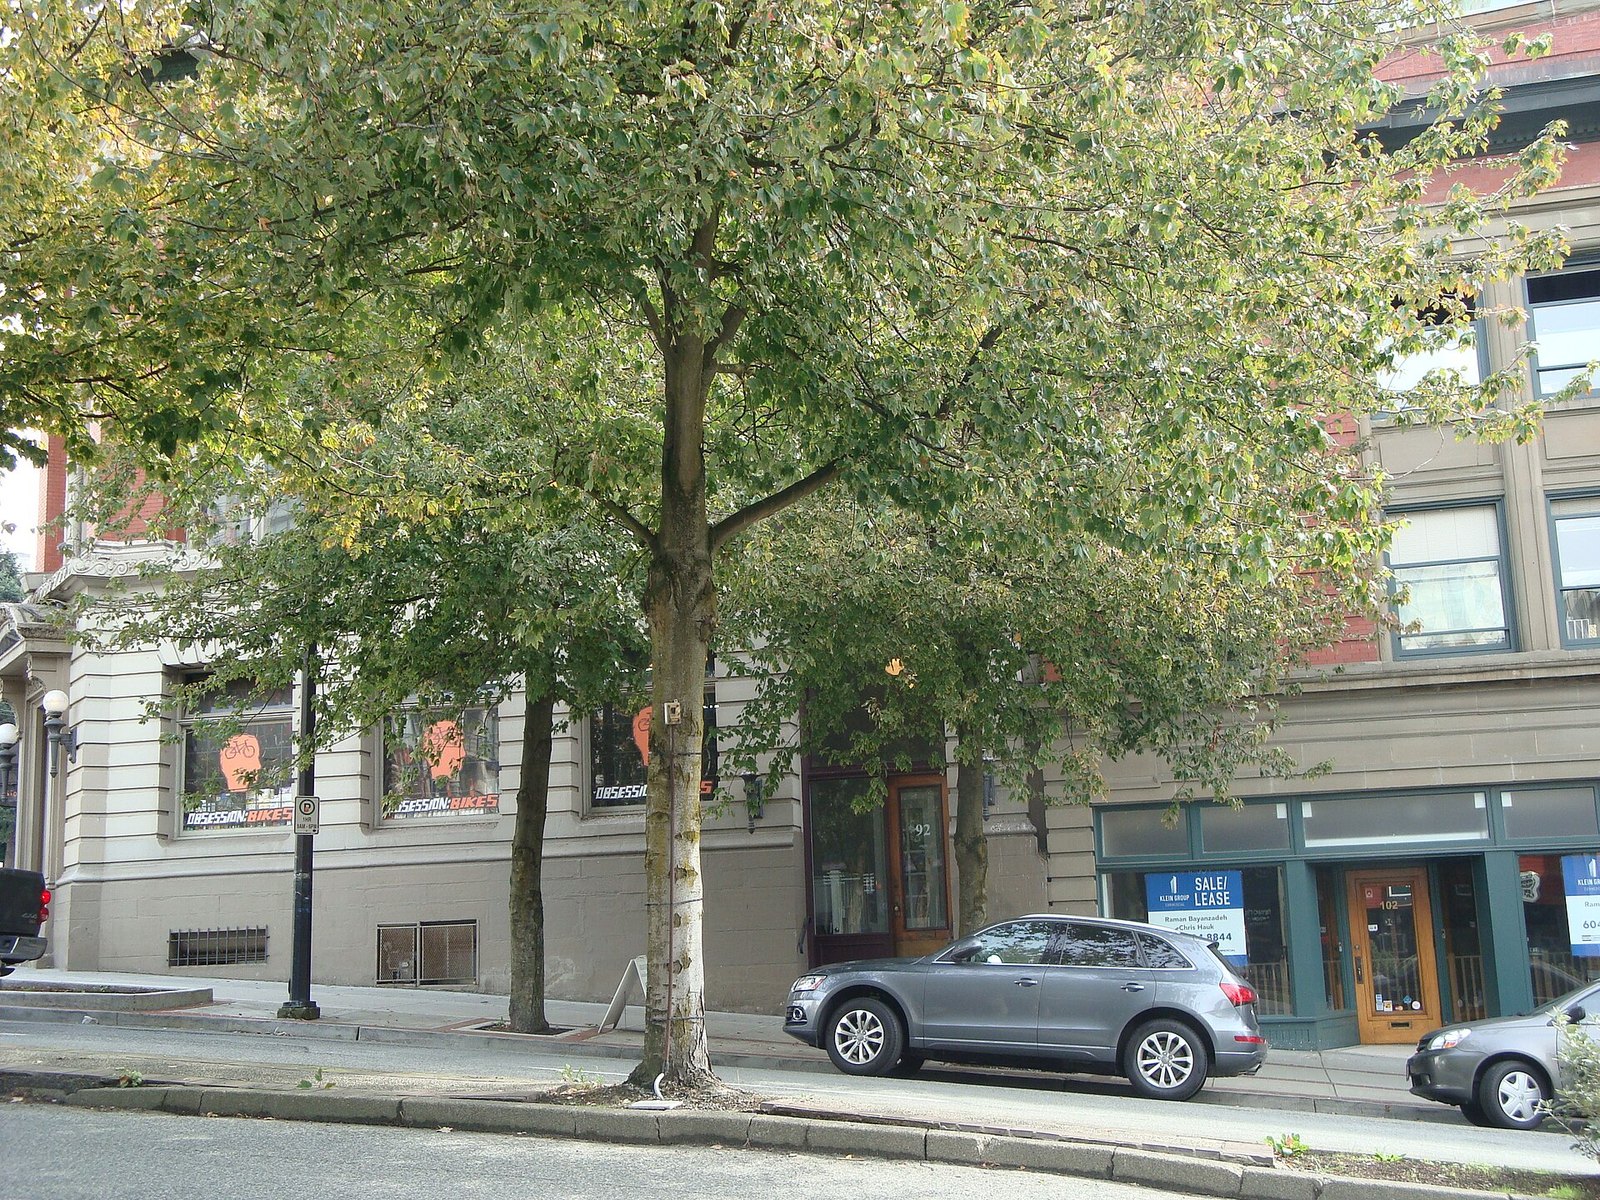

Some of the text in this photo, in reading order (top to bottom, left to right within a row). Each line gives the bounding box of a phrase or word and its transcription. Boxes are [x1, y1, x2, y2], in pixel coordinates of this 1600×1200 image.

[915, 823, 931, 837] 92
[1195, 876, 1227, 891] SALE/
[1194, 891, 1231, 907] LEASE
[1379, 900, 1399, 911] 102
